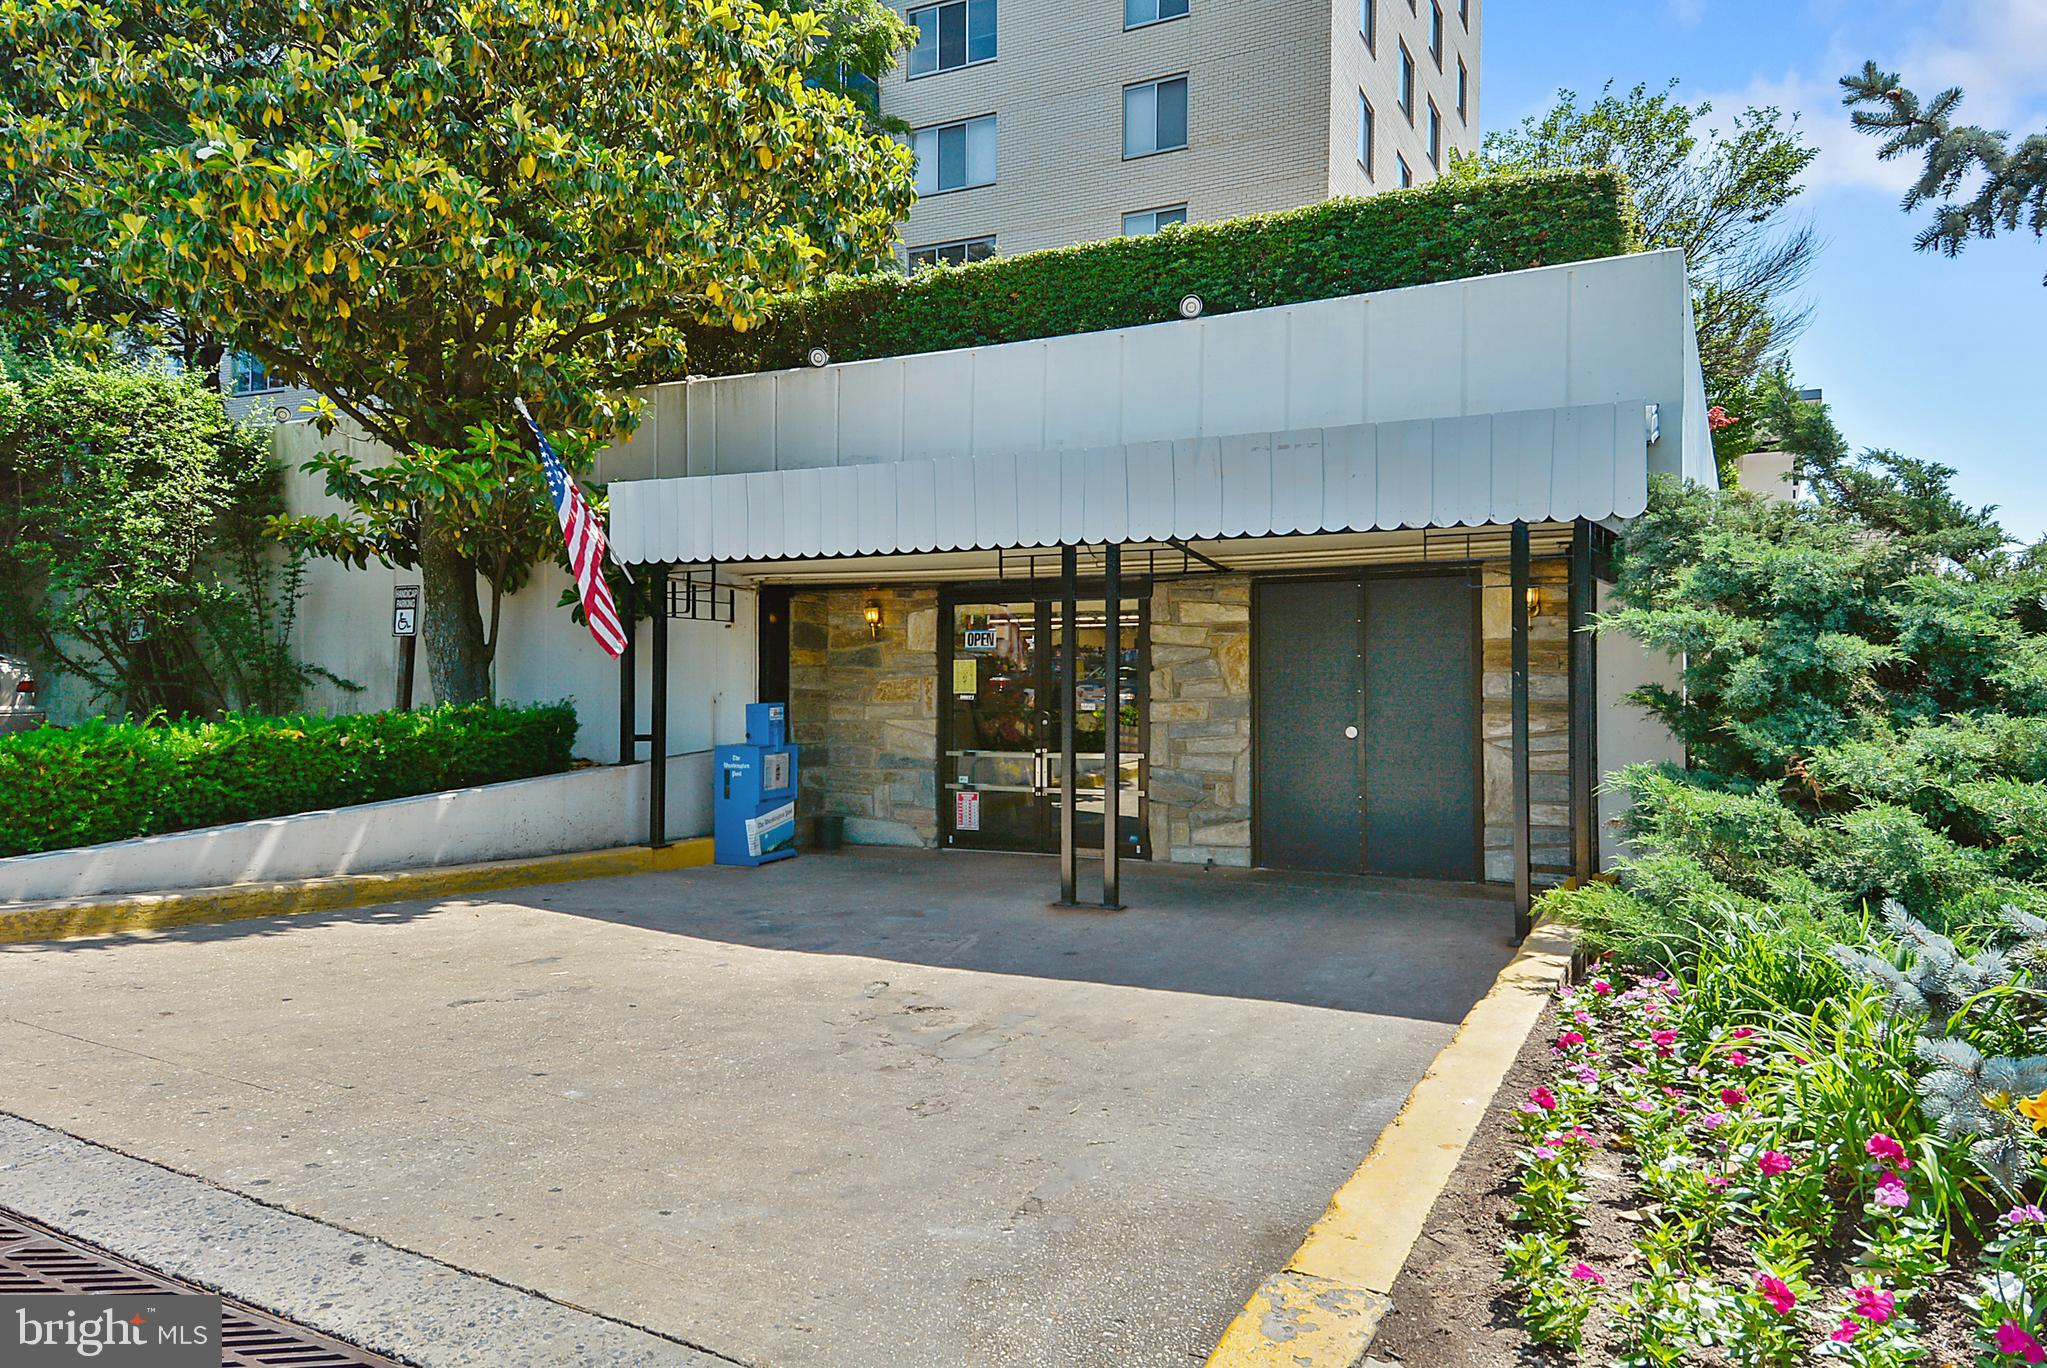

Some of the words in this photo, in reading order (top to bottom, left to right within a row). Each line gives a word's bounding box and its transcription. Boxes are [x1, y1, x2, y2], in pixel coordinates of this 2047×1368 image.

[396, 589, 417, 598] HANDICAP
[396, 599, 416, 608] PARKING
[967, 632, 994, 646] OPEN
